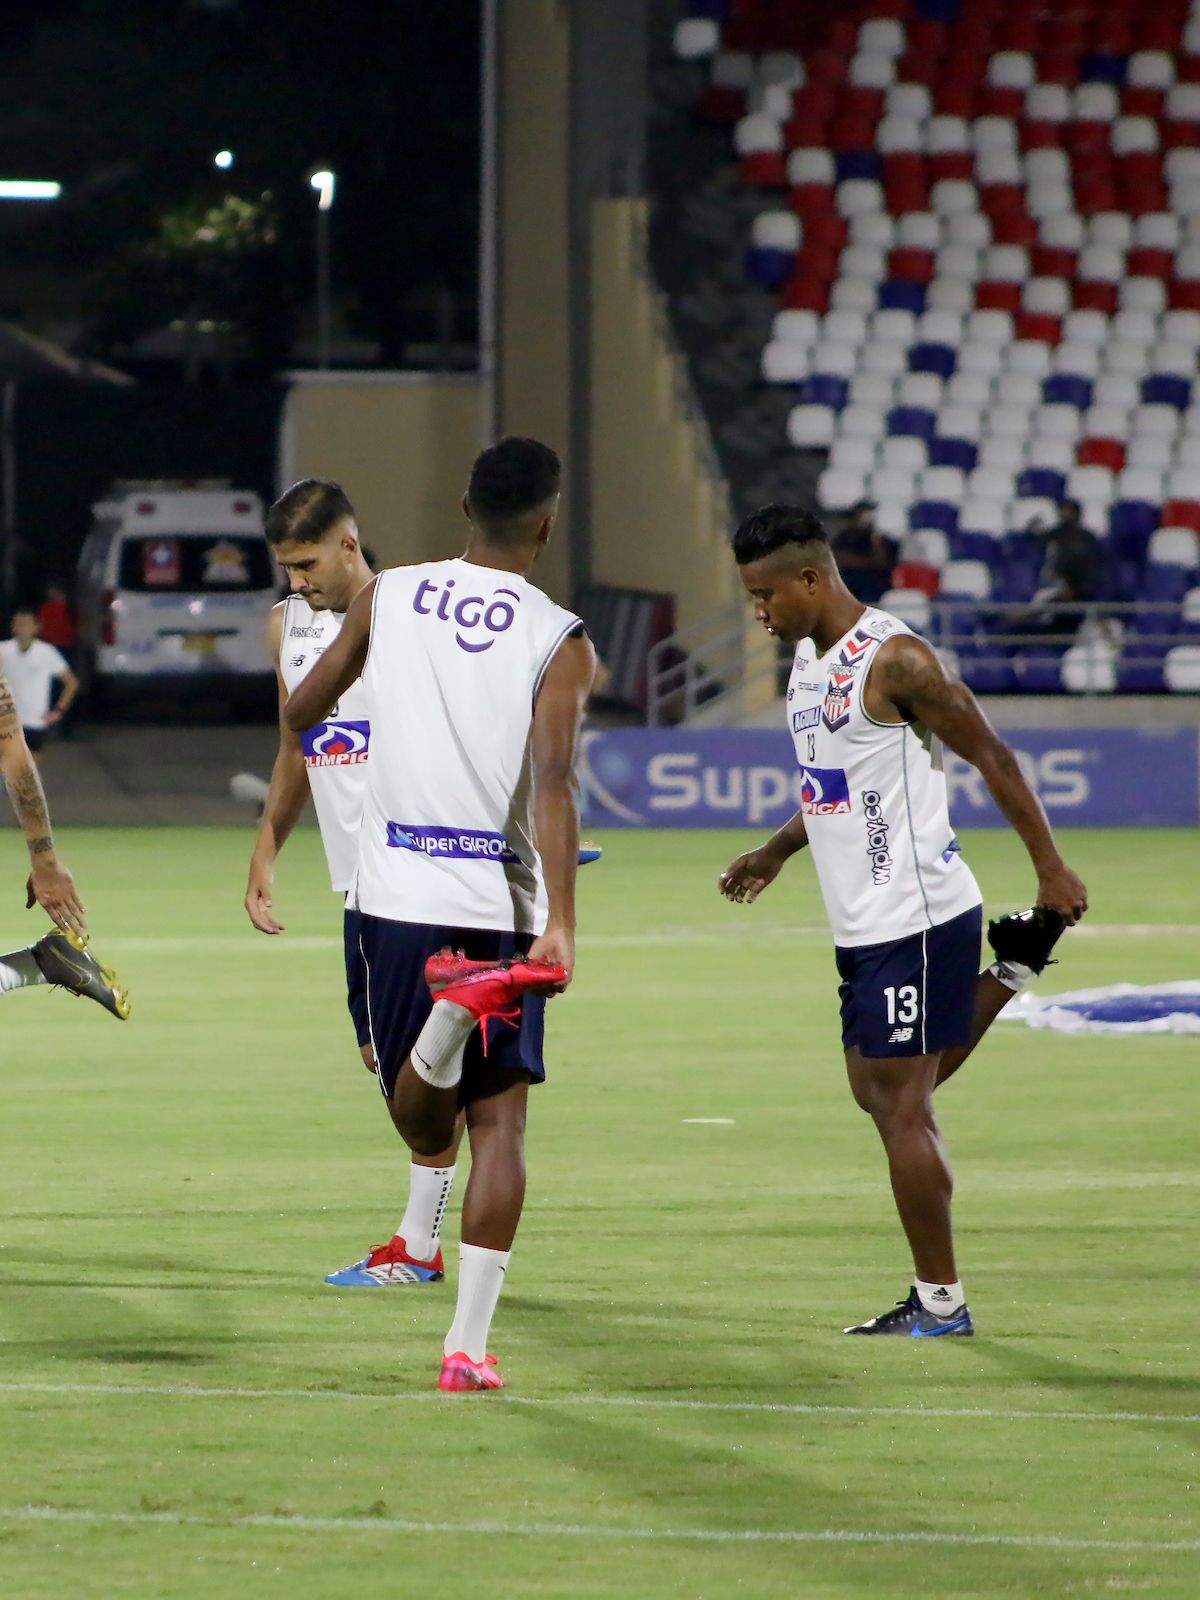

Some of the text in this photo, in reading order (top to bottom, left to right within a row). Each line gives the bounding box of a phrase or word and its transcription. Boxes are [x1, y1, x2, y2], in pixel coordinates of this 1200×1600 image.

[413, 579, 518, 653] tigo
[647, 753, 801, 822] Sup
[861, 790, 893, 885] wplay.co
[883, 985, 918, 1024] 13
